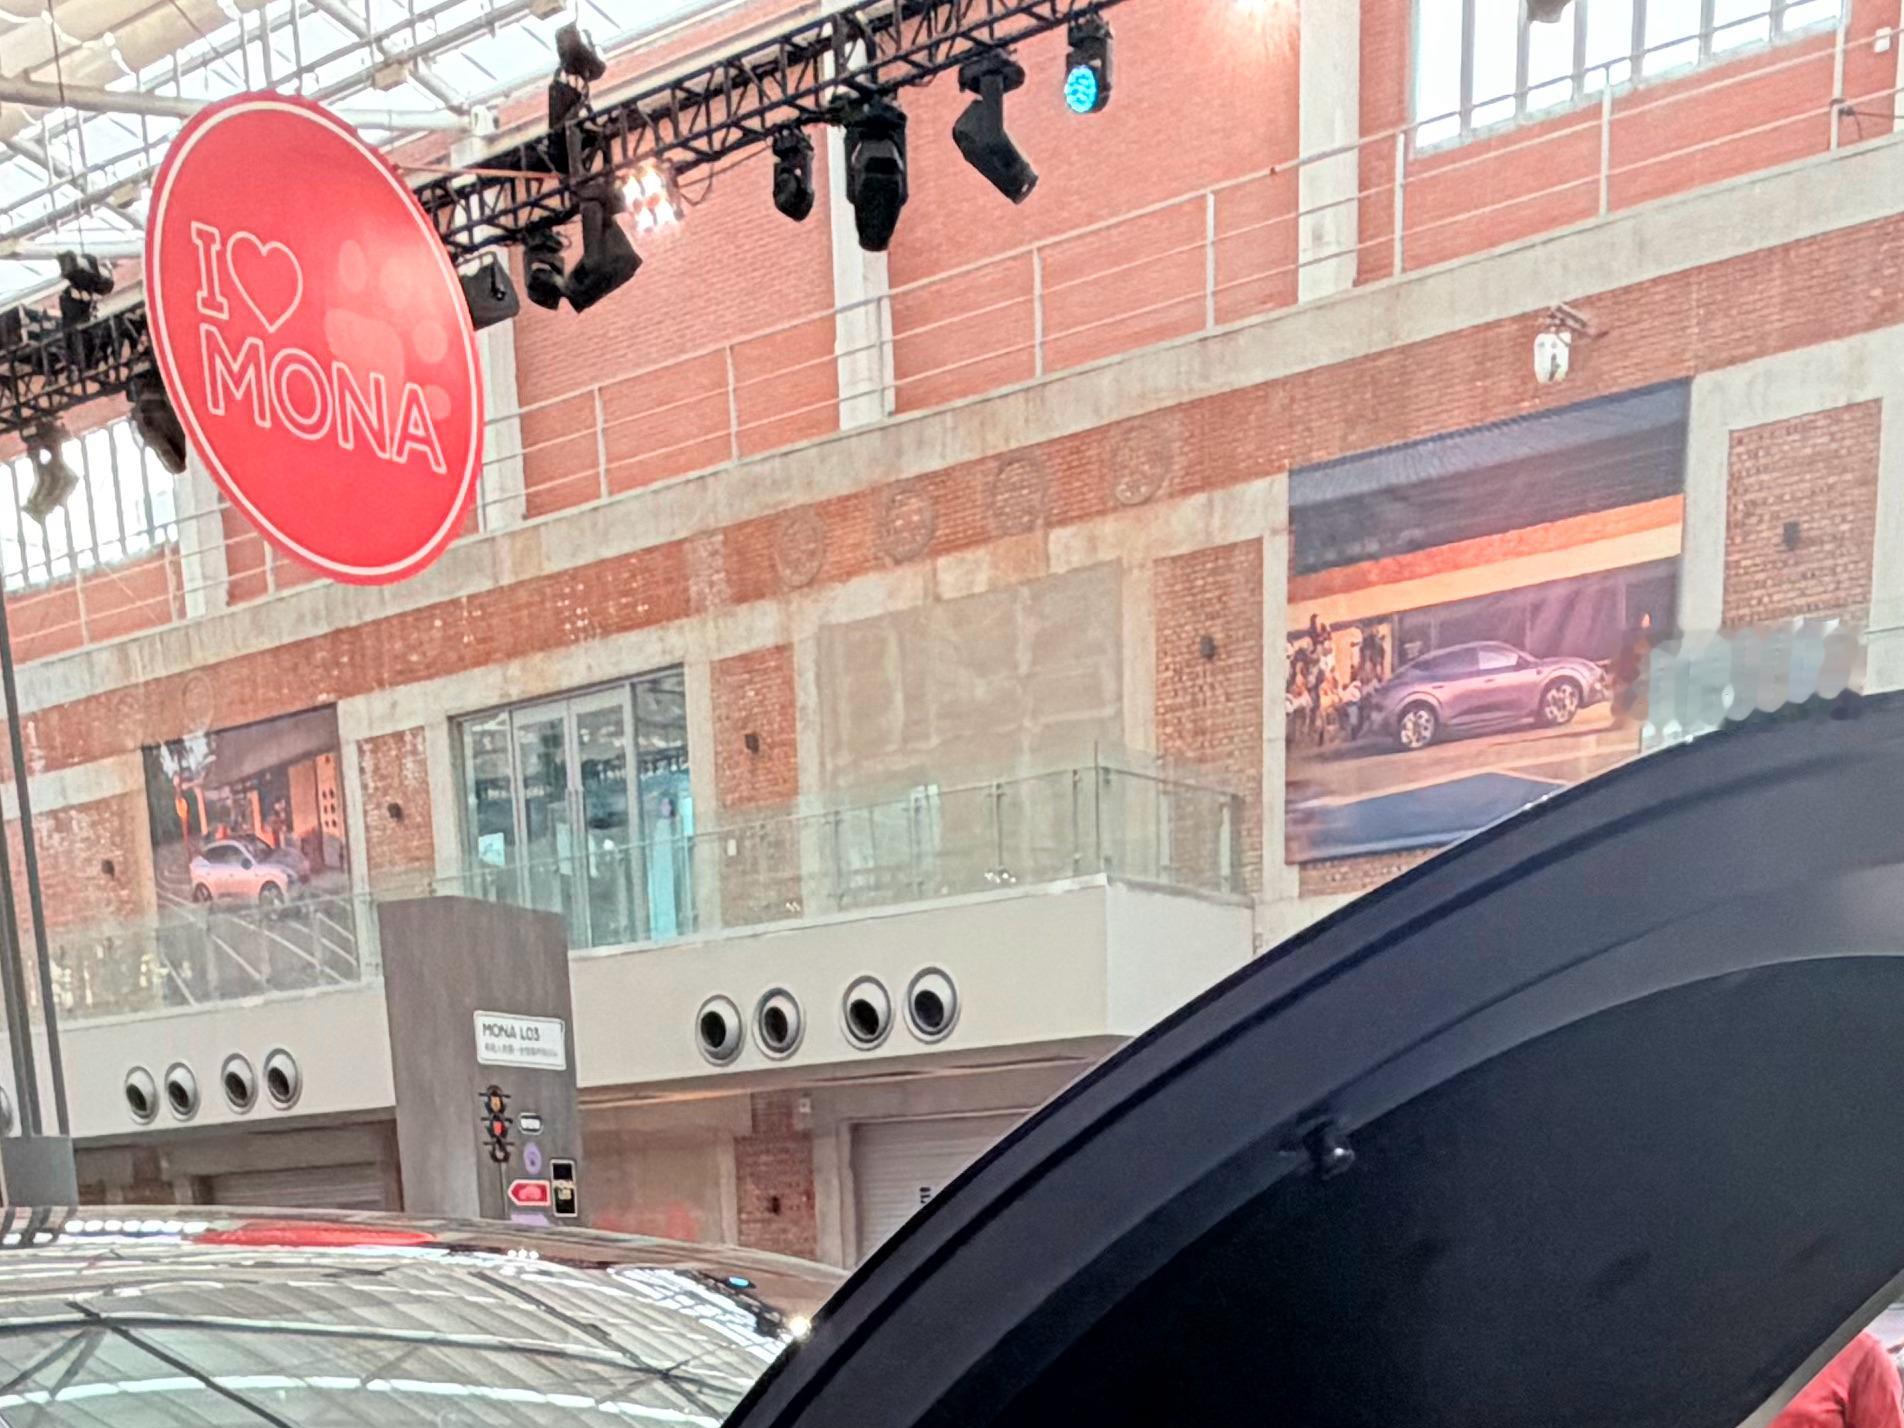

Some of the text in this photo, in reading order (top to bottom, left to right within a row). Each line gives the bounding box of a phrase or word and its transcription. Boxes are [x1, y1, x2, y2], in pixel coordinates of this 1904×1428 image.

[190, 220, 230, 321] I
[199, 322, 448, 475] MONA
[482, 1022, 517, 1039] MONA
